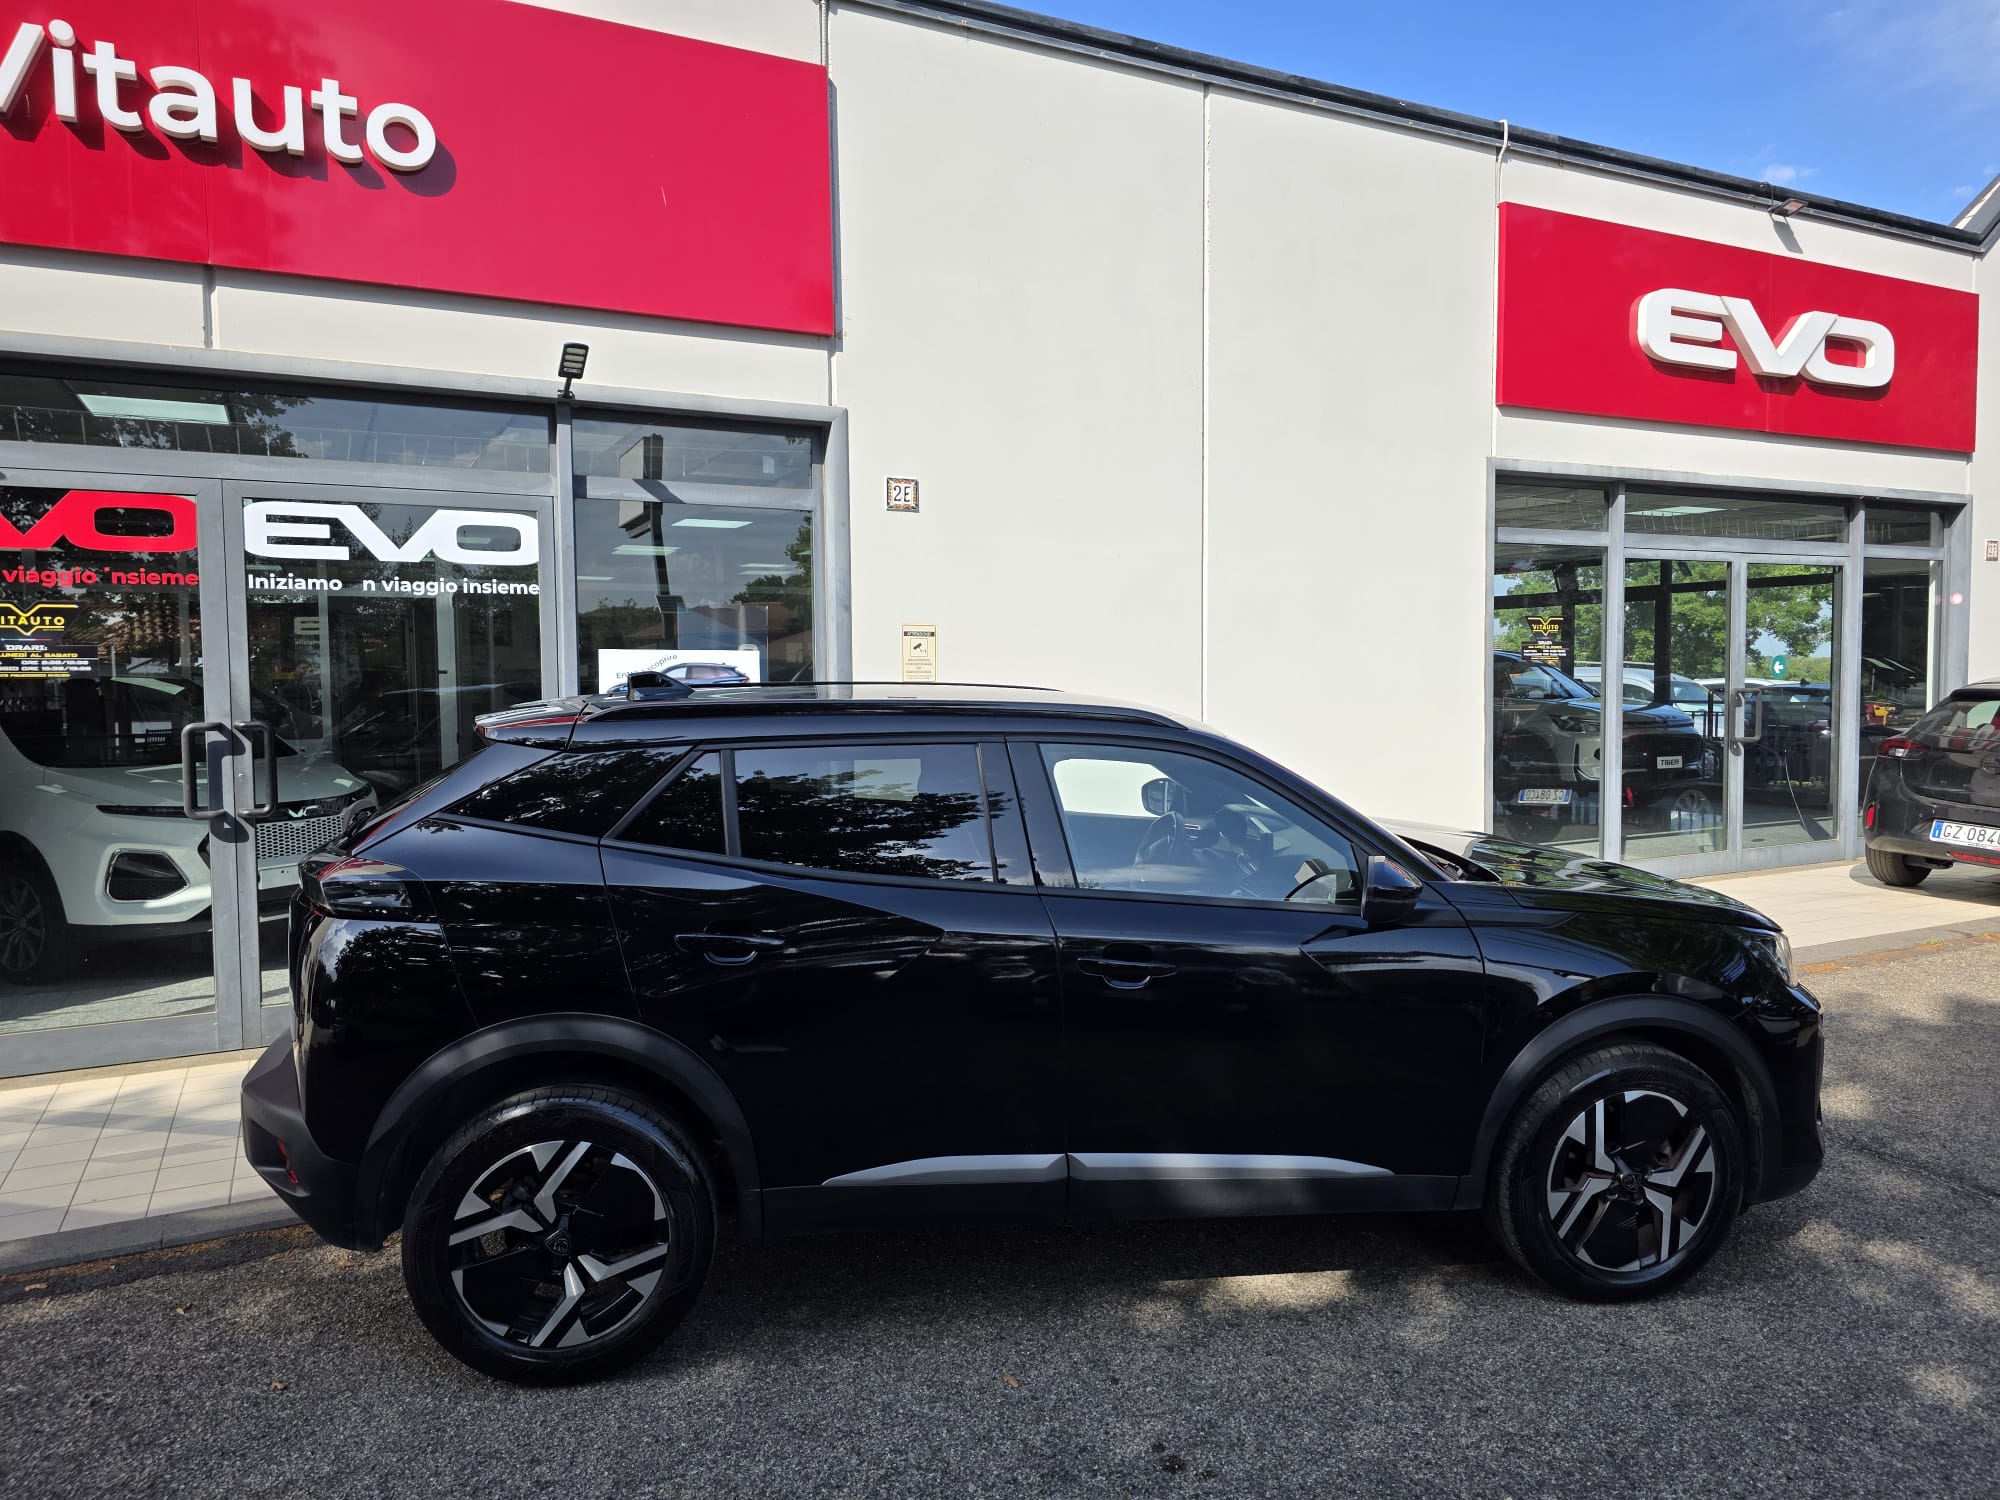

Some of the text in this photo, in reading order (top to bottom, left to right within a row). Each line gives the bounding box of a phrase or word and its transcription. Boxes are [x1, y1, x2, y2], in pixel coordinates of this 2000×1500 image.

[1636, 287, 1896, 389] EVO
[893, 485, 911, 502] 2E
[243, 500, 540, 566] EVO
[2, 565, 200, 587] viaggio nsieme
[247, 572, 343, 591] Iniziamo
[380, 576, 458, 596] viaggio
[462, 577, 540, 595] insieme
[0, 615, 65, 626] ITAUTO
[1943, 824, 1963, 839] GZ
